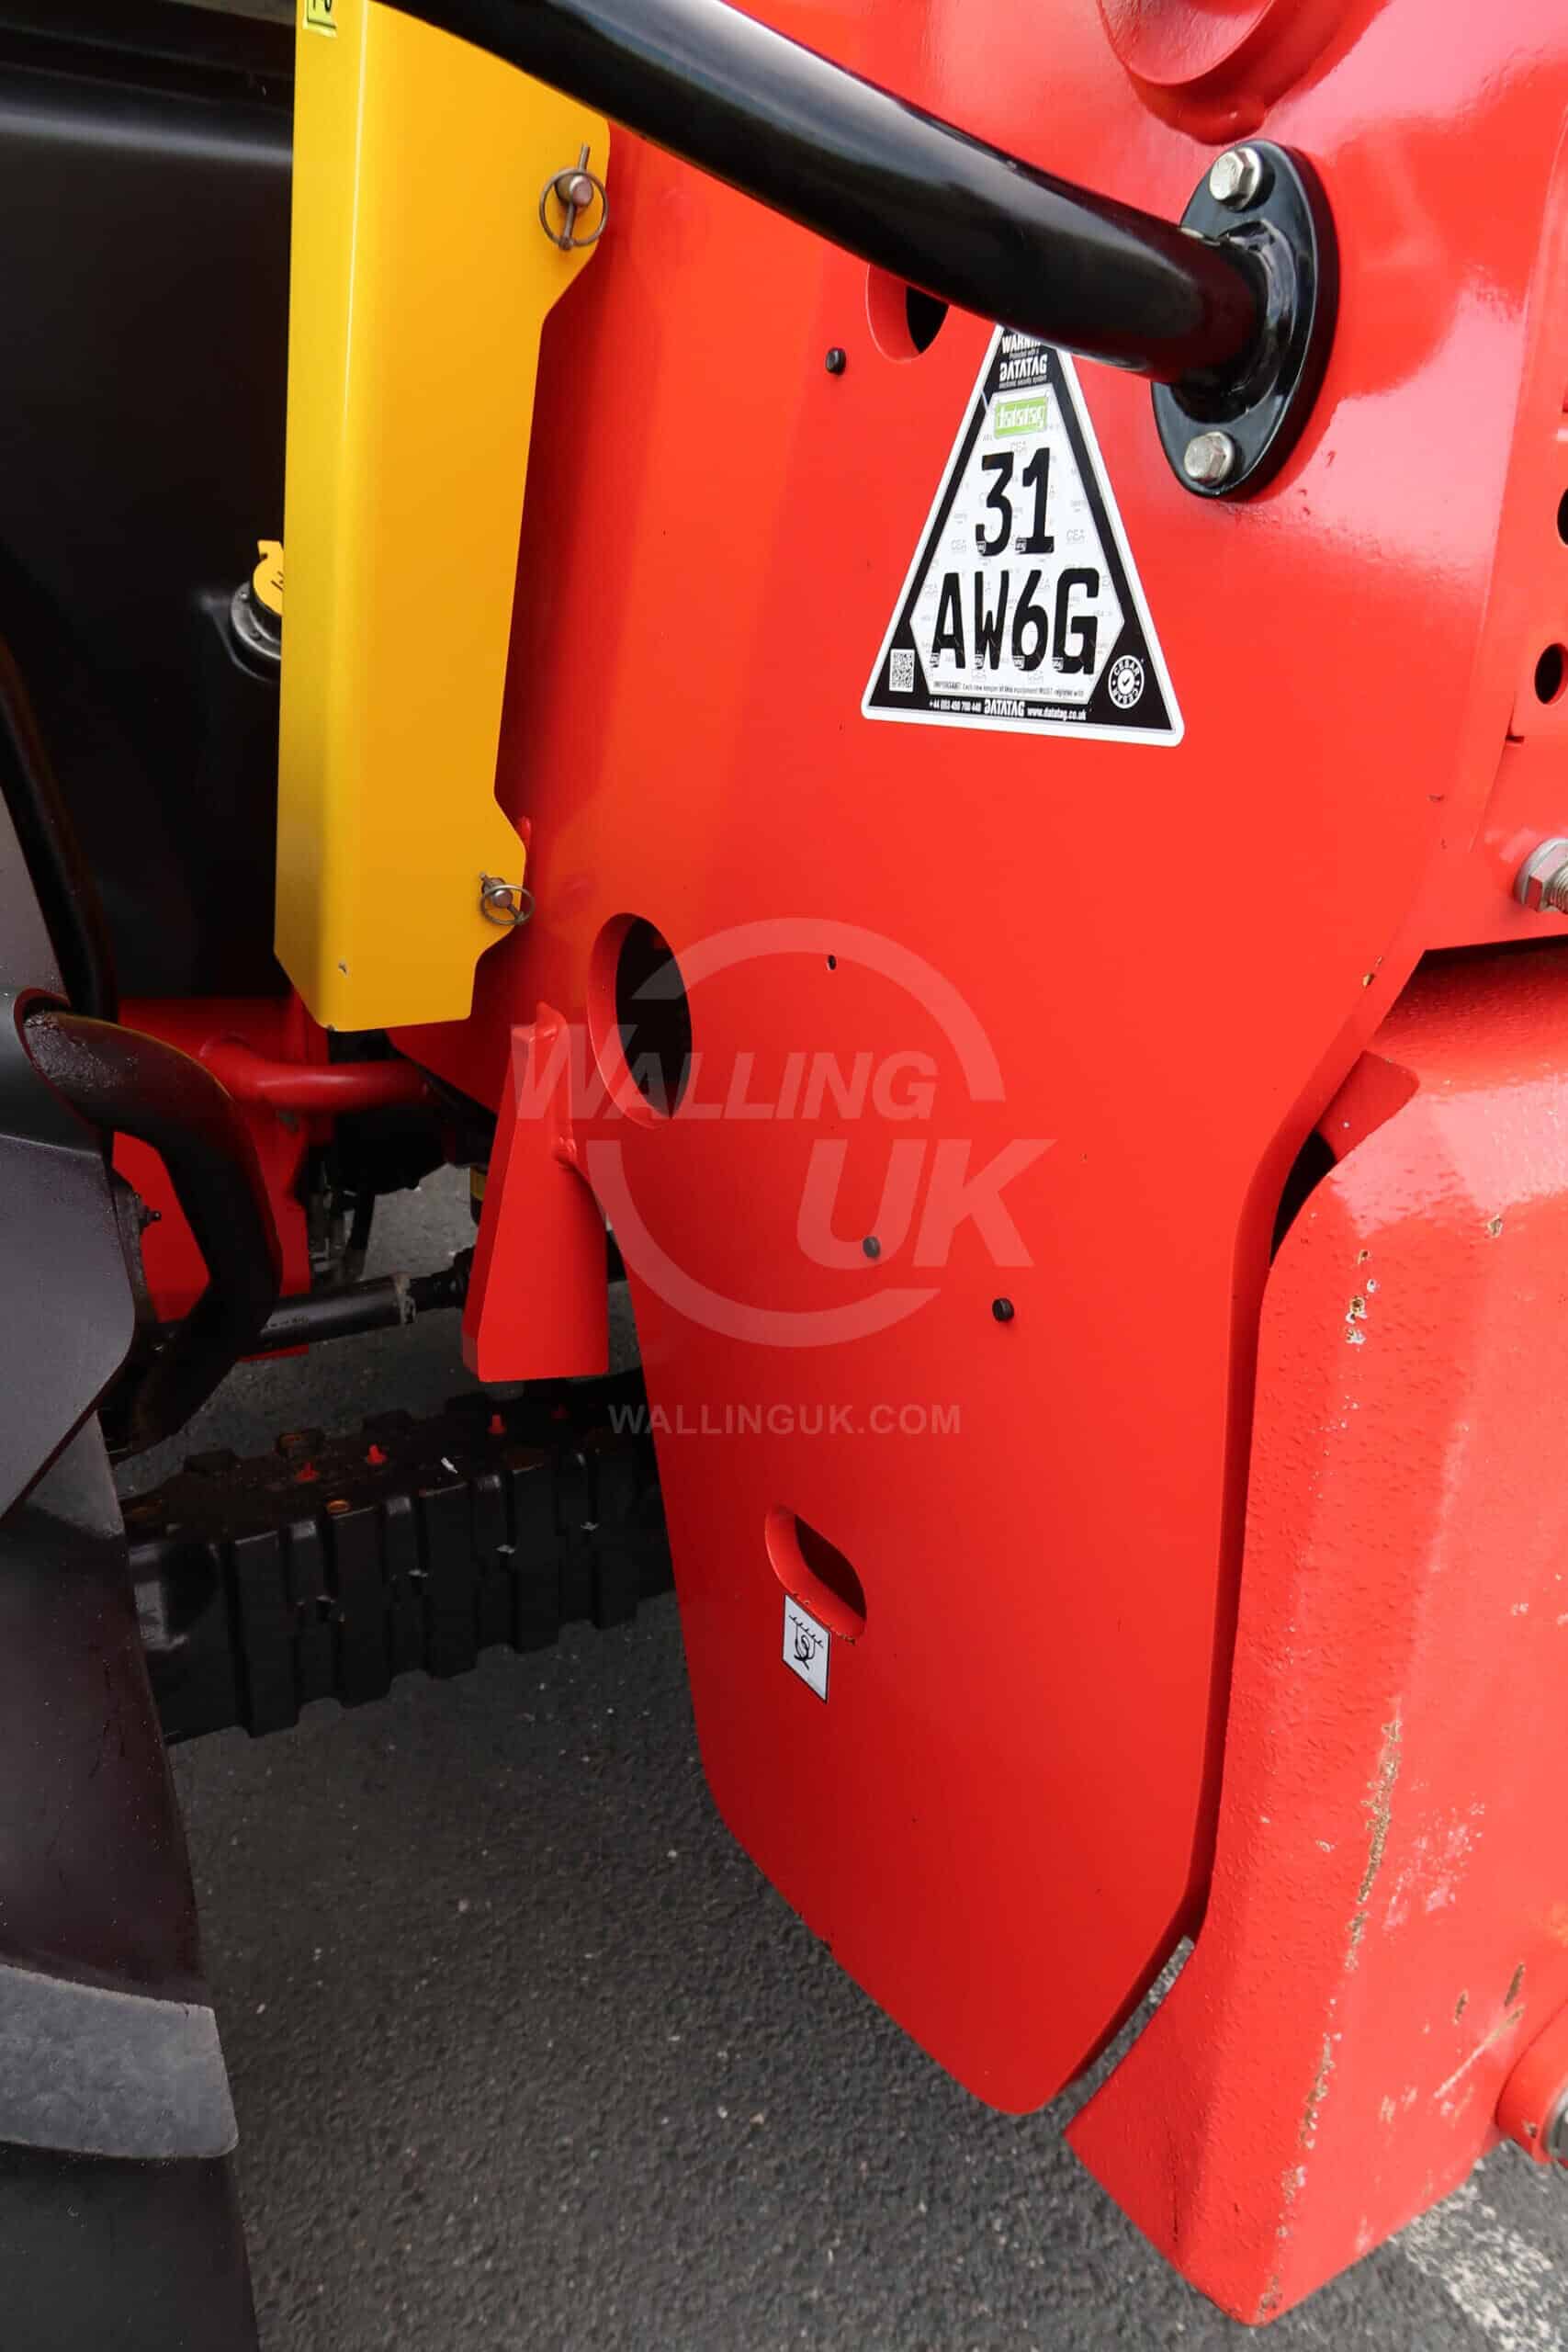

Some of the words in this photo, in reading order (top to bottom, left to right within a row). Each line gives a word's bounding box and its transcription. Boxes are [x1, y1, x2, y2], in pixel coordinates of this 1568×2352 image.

[999, 354, 1047, 382] DATATAG
[976, 447, 1055, 557] 31
[930, 568, 1100, 674] AW6G
[984, 698, 1025, 717] DATATAG
